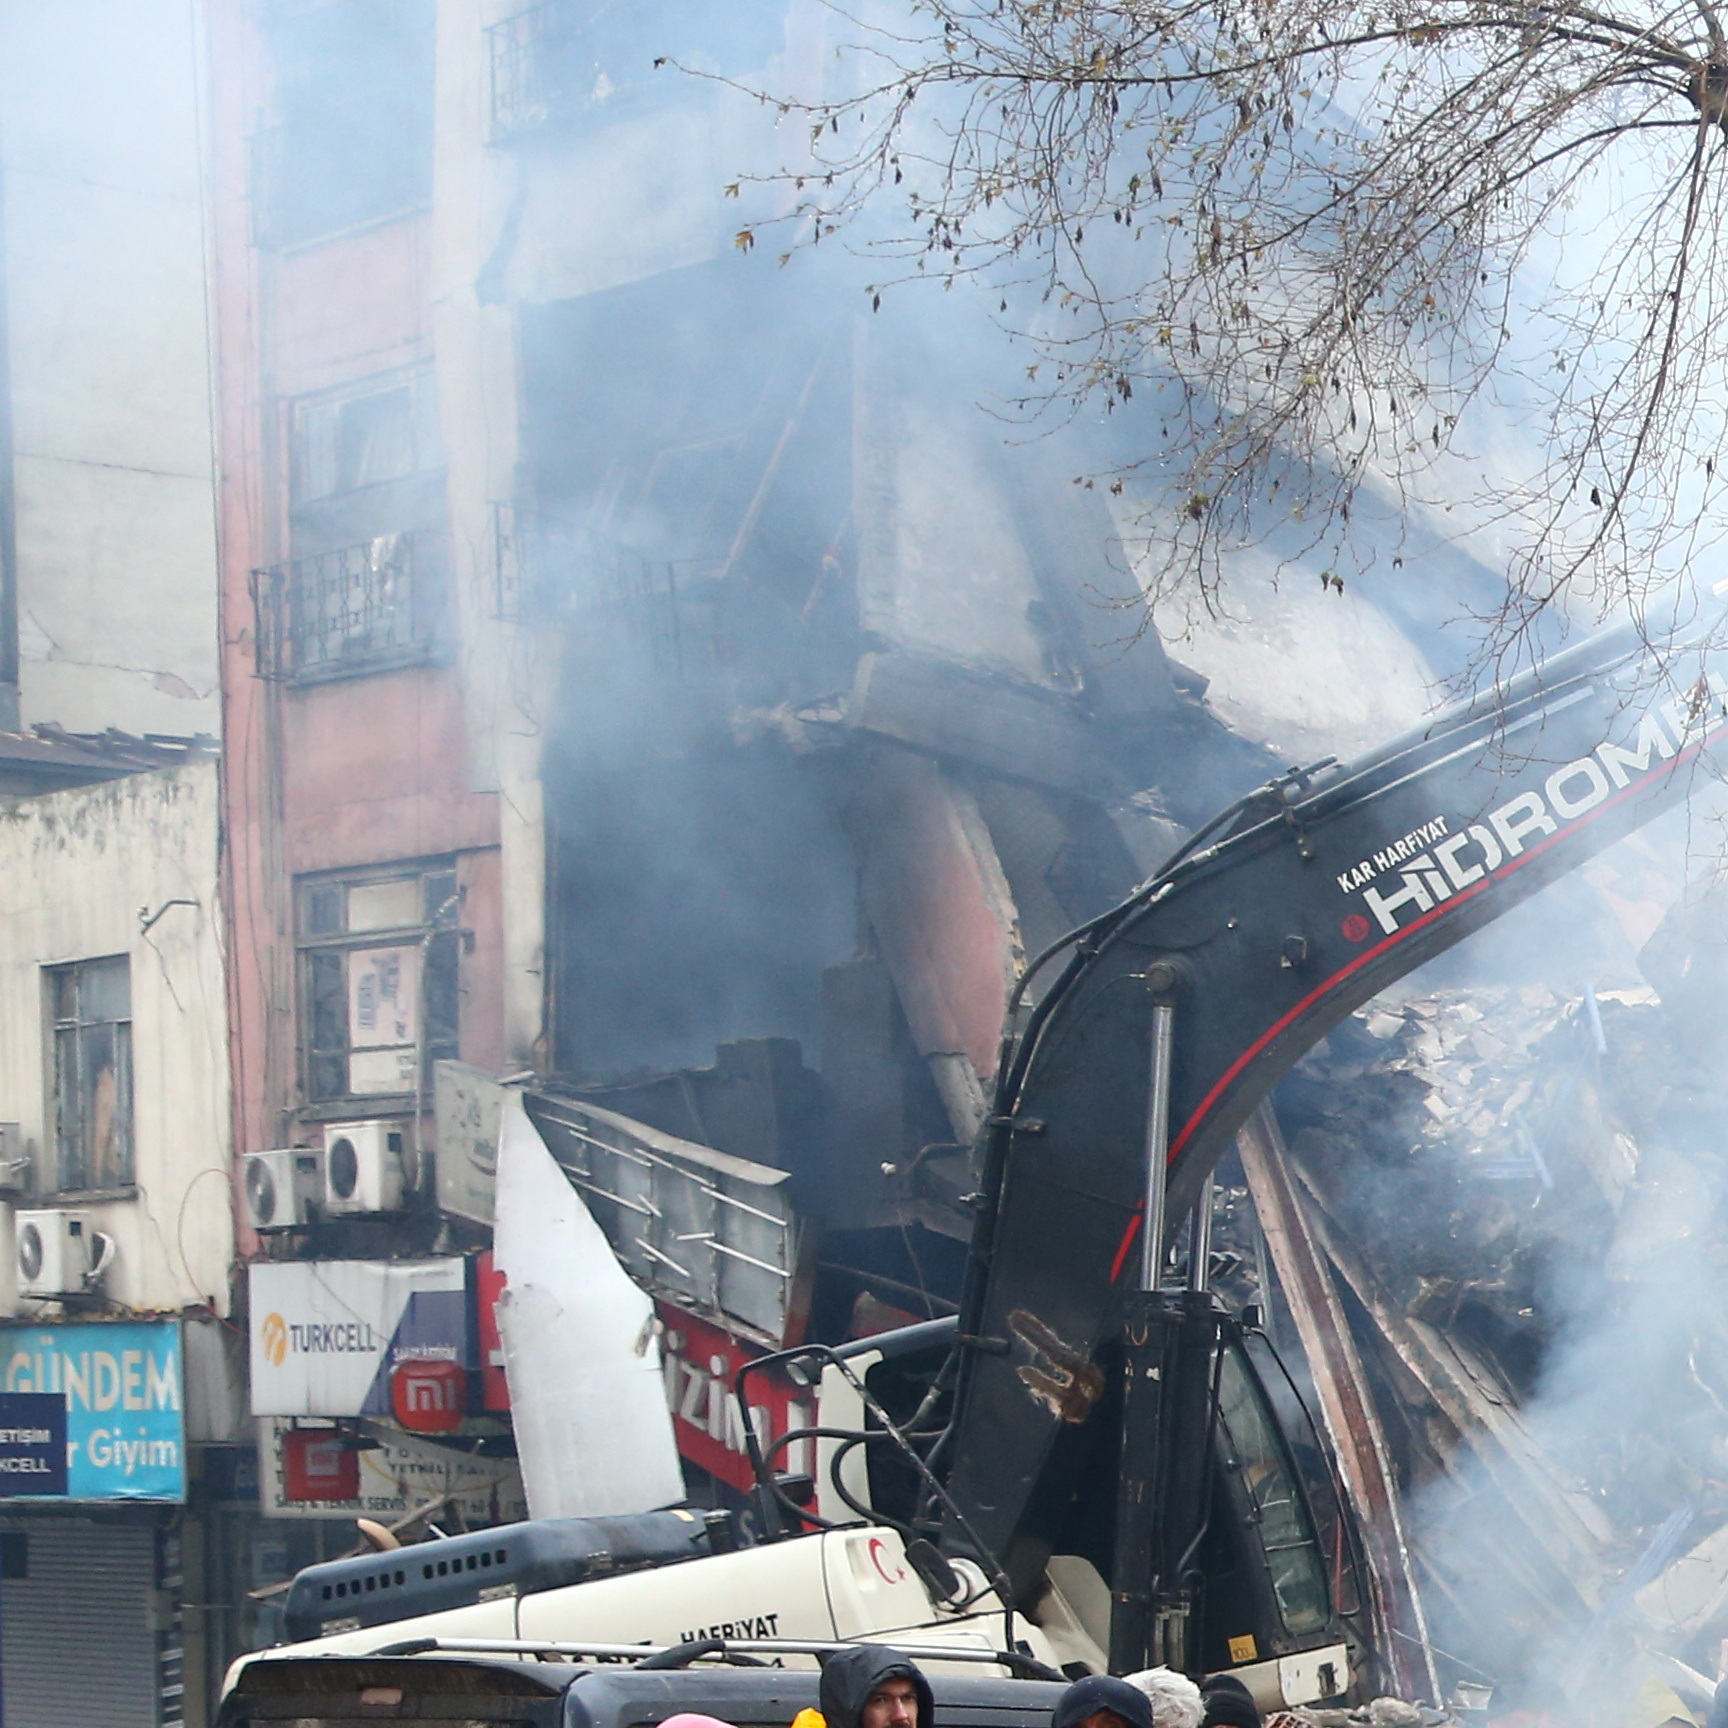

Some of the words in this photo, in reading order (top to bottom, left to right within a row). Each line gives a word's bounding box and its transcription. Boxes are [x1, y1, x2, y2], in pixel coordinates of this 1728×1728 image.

[1336, 860, 1377, 894] KAR
[290, 1323, 377, 1352] TURKCELL
[6, 1335, 181, 1412] GÜNDEM
[87, 1426, 178, 1476] Giyim
